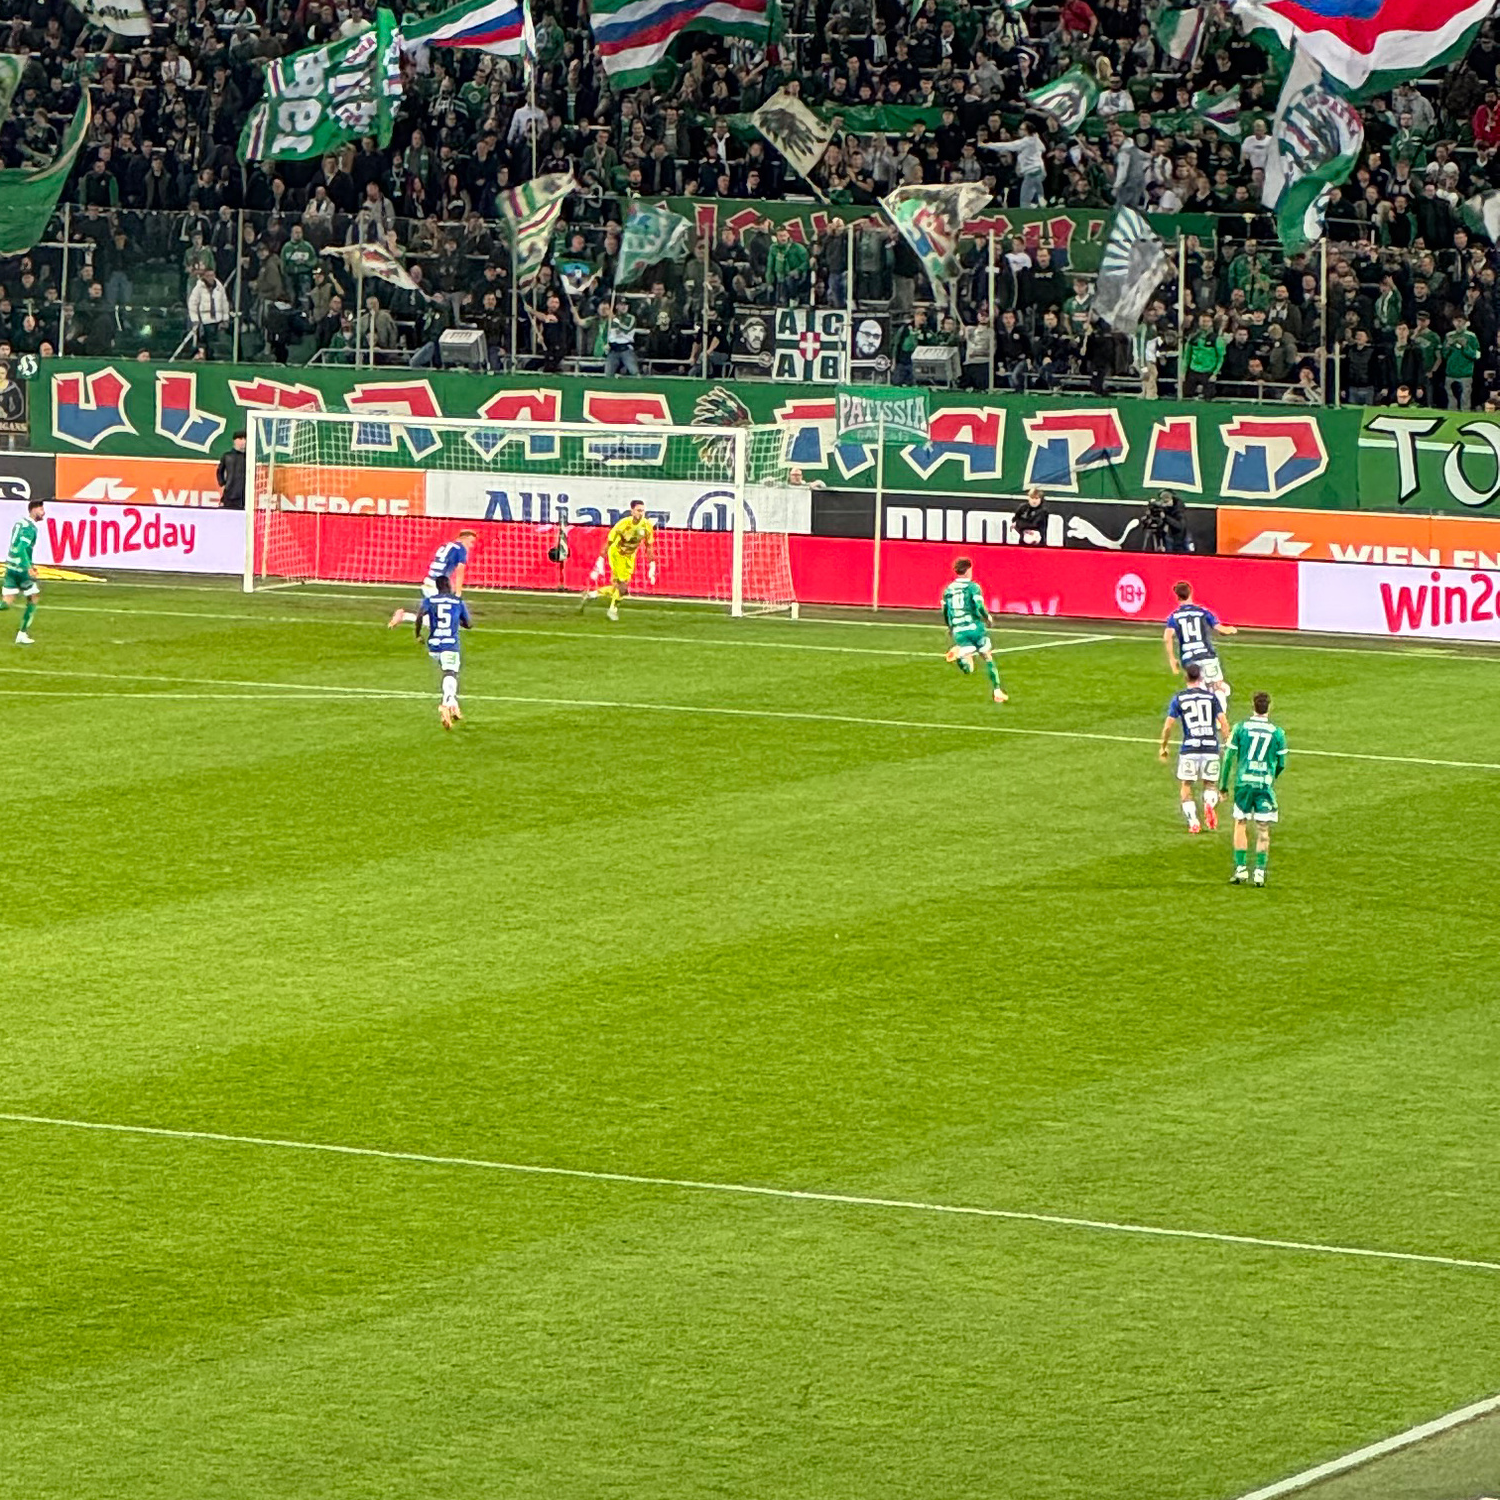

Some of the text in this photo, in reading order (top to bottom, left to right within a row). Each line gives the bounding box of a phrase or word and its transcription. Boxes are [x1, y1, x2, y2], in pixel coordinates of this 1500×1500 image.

[51, 366, 673, 466] ULTRAS
[839, 393, 928, 432] PATISSIA
[152, 487, 222, 508] WIE
[1328, 543, 1441, 567] WIEN
[1119, 583, 1146, 603] 18+
[1380, 571, 1500, 633] win2
[437, 603, 452, 629] 5
[1178, 616, 1203, 643] 14
[1181, 699, 1213, 728] 20
[1247, 731, 1272, 761] 77
